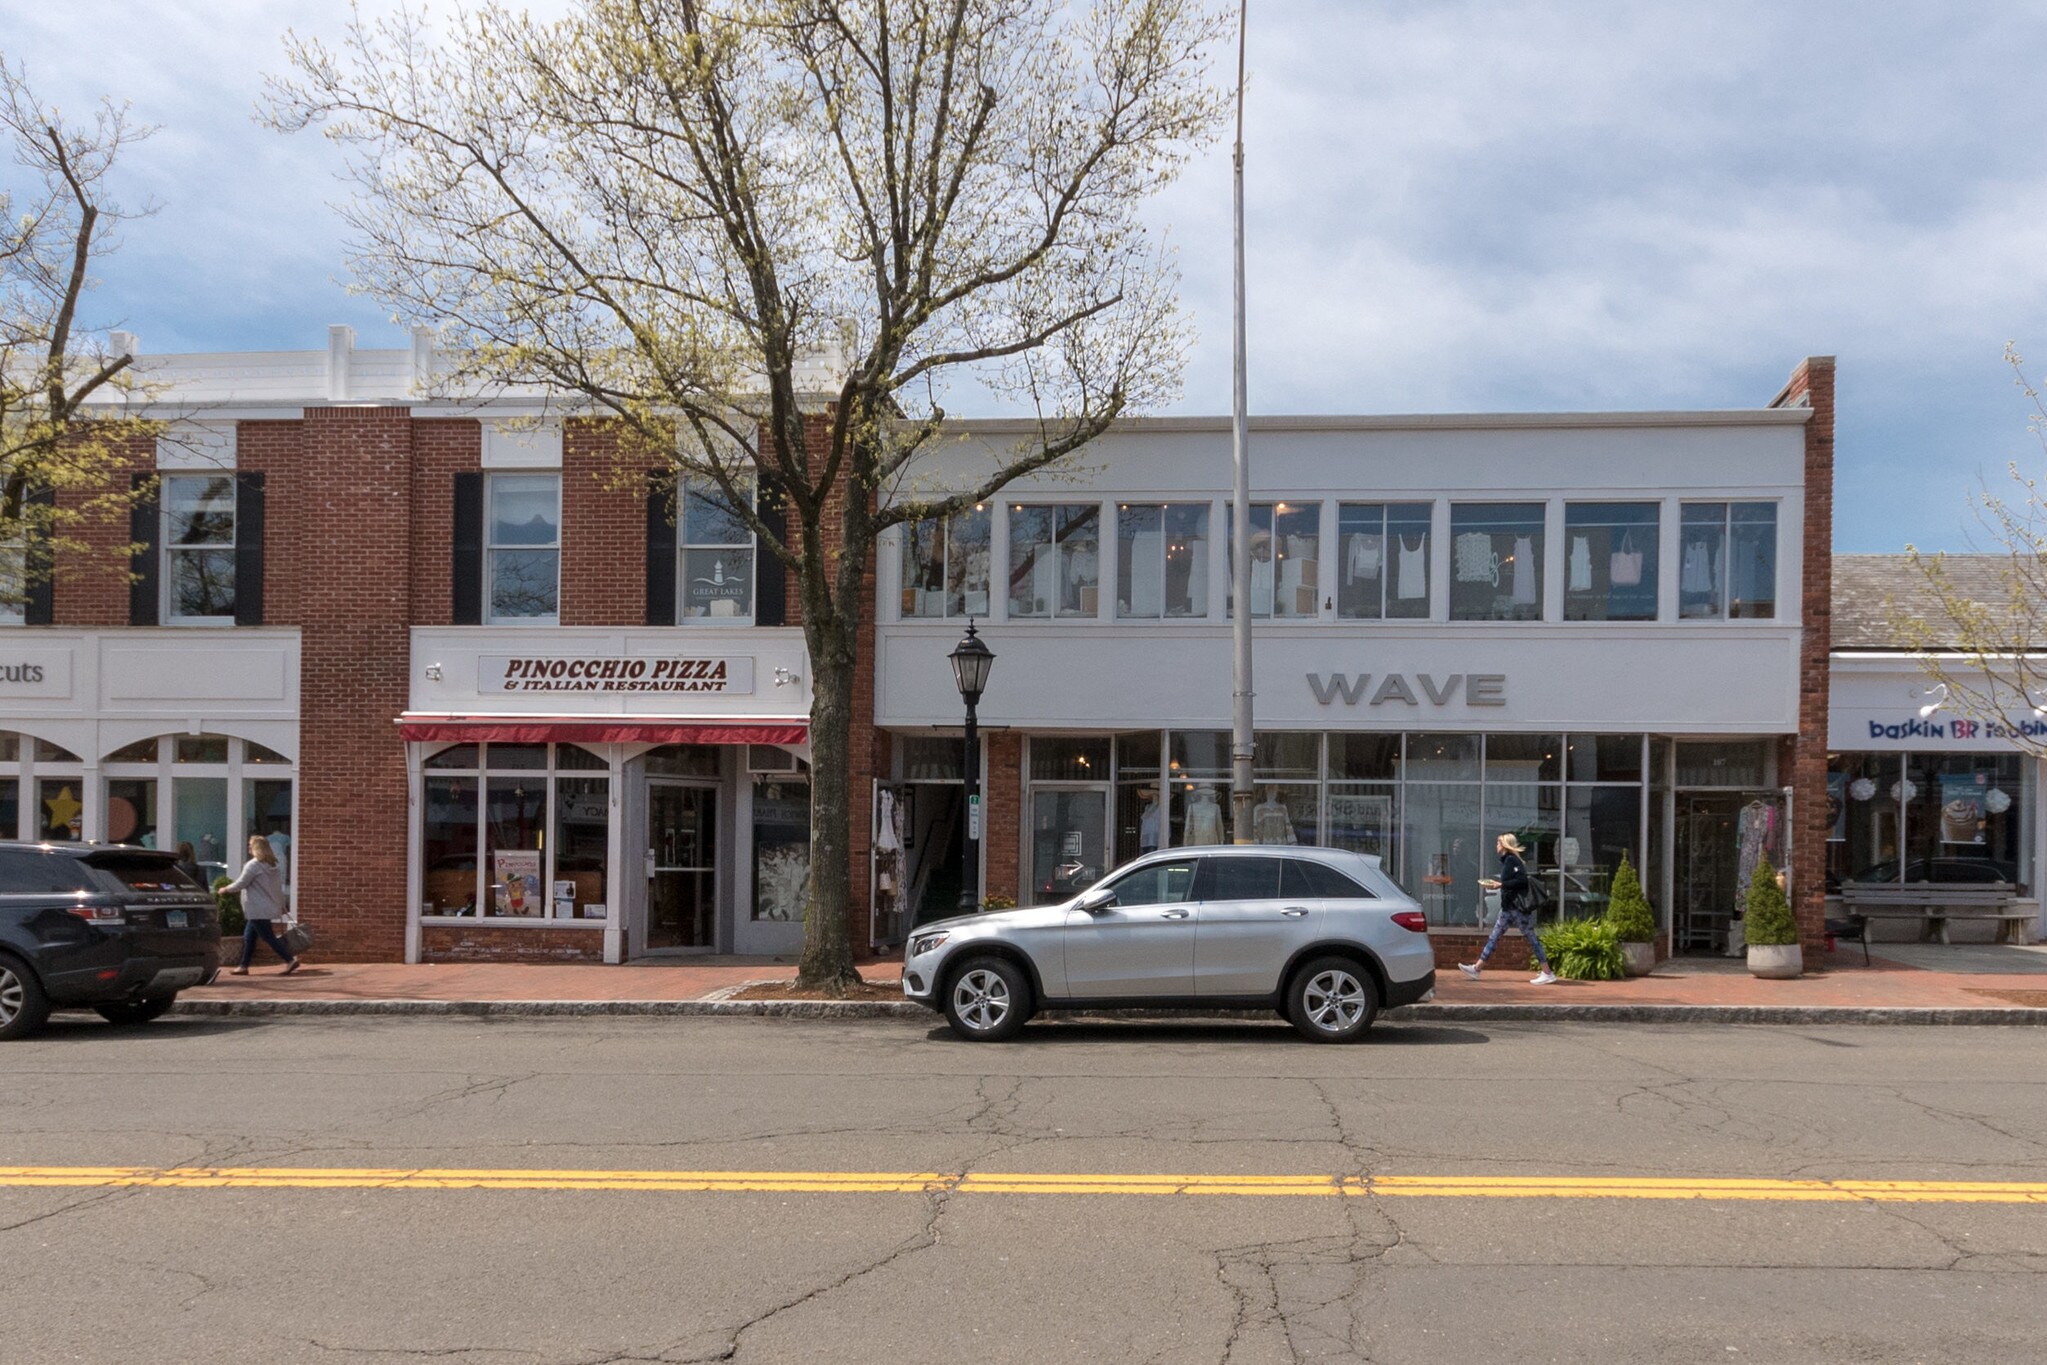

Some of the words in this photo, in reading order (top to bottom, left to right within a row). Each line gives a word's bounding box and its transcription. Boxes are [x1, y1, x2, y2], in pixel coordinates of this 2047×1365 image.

[693, 588, 718, 596] GREAT
[720, 588, 744, 596] LAKES
[504, 659, 647, 679] PINOCCHIO
[651, 660, 727, 680] PIZZA
[503, 680, 519, 690] &
[522, 680, 598, 691] ITALIAN
[601, 681, 727, 692] RESTAURANT
[1306, 673, 1506, 706] WAVE
